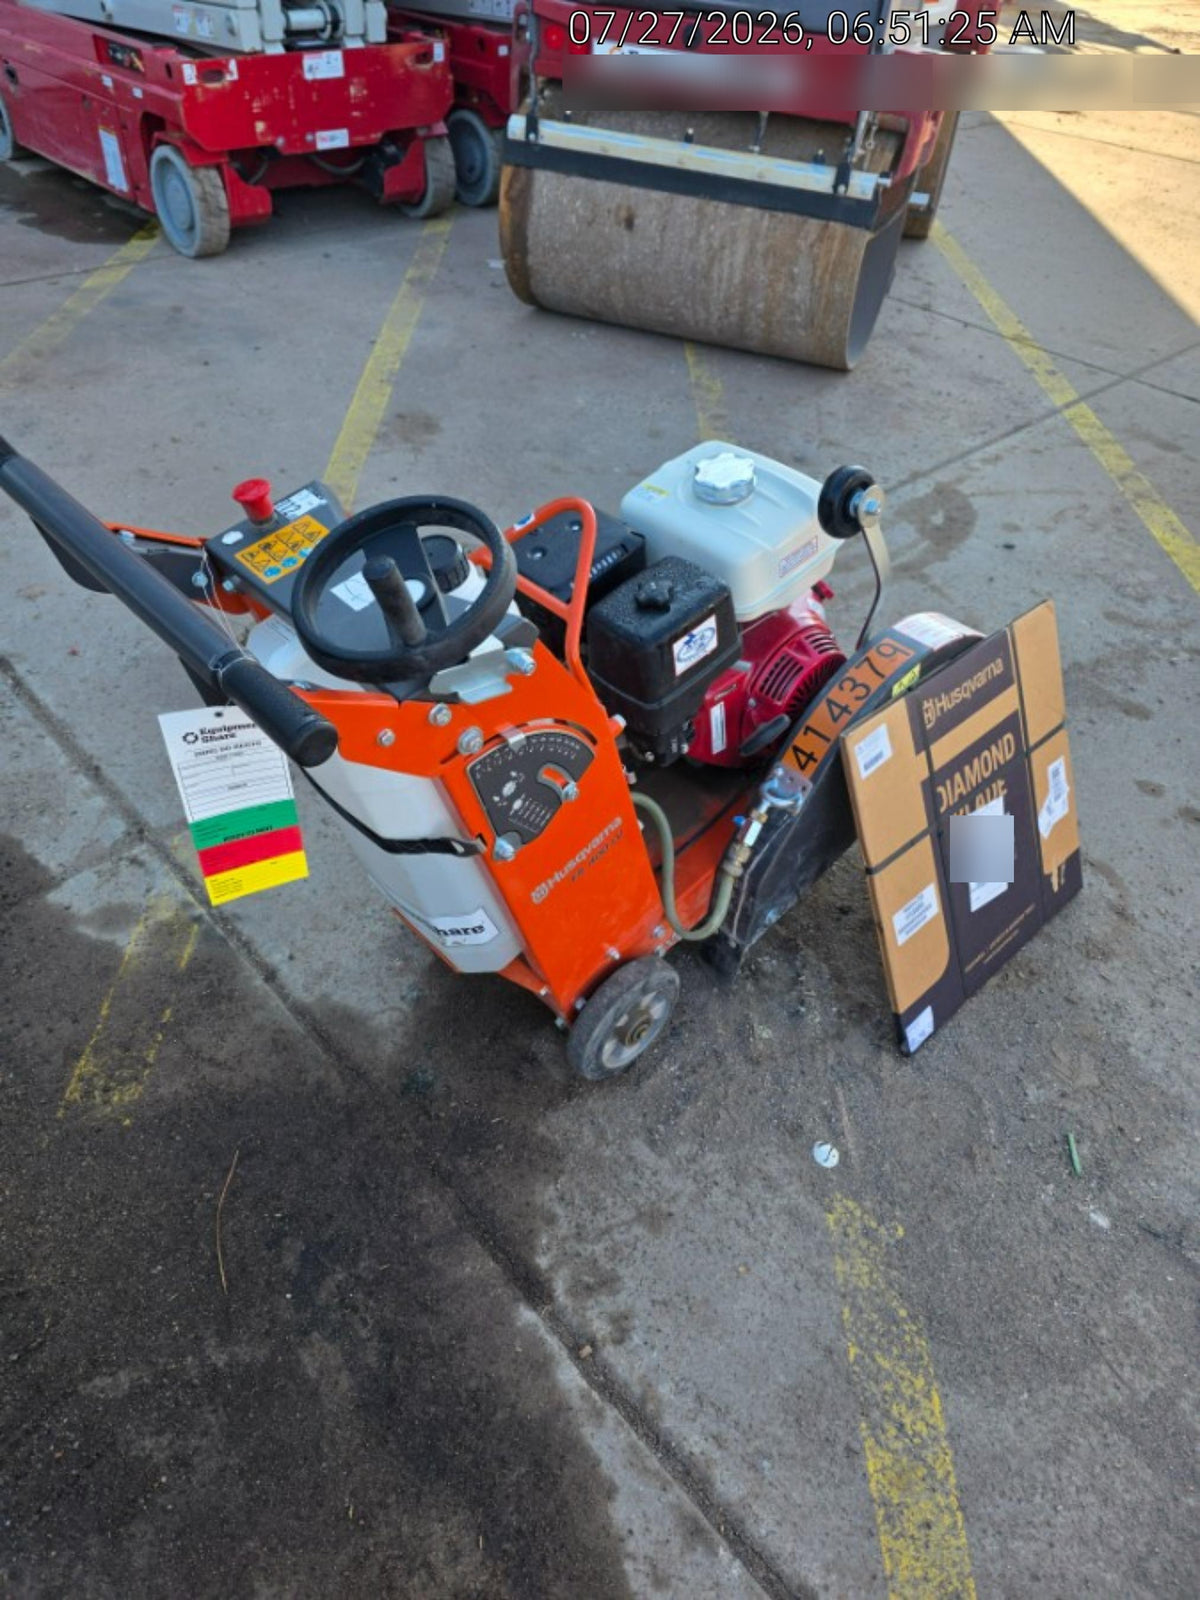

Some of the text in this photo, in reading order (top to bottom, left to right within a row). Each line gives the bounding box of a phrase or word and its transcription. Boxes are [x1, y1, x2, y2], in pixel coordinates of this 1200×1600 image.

[934, 657, 1004, 717] Husqvarna
[199, 722, 257, 735] Equipme
[546, 816, 623, 890] Husqvarna
[432, 924, 485, 936] hare
